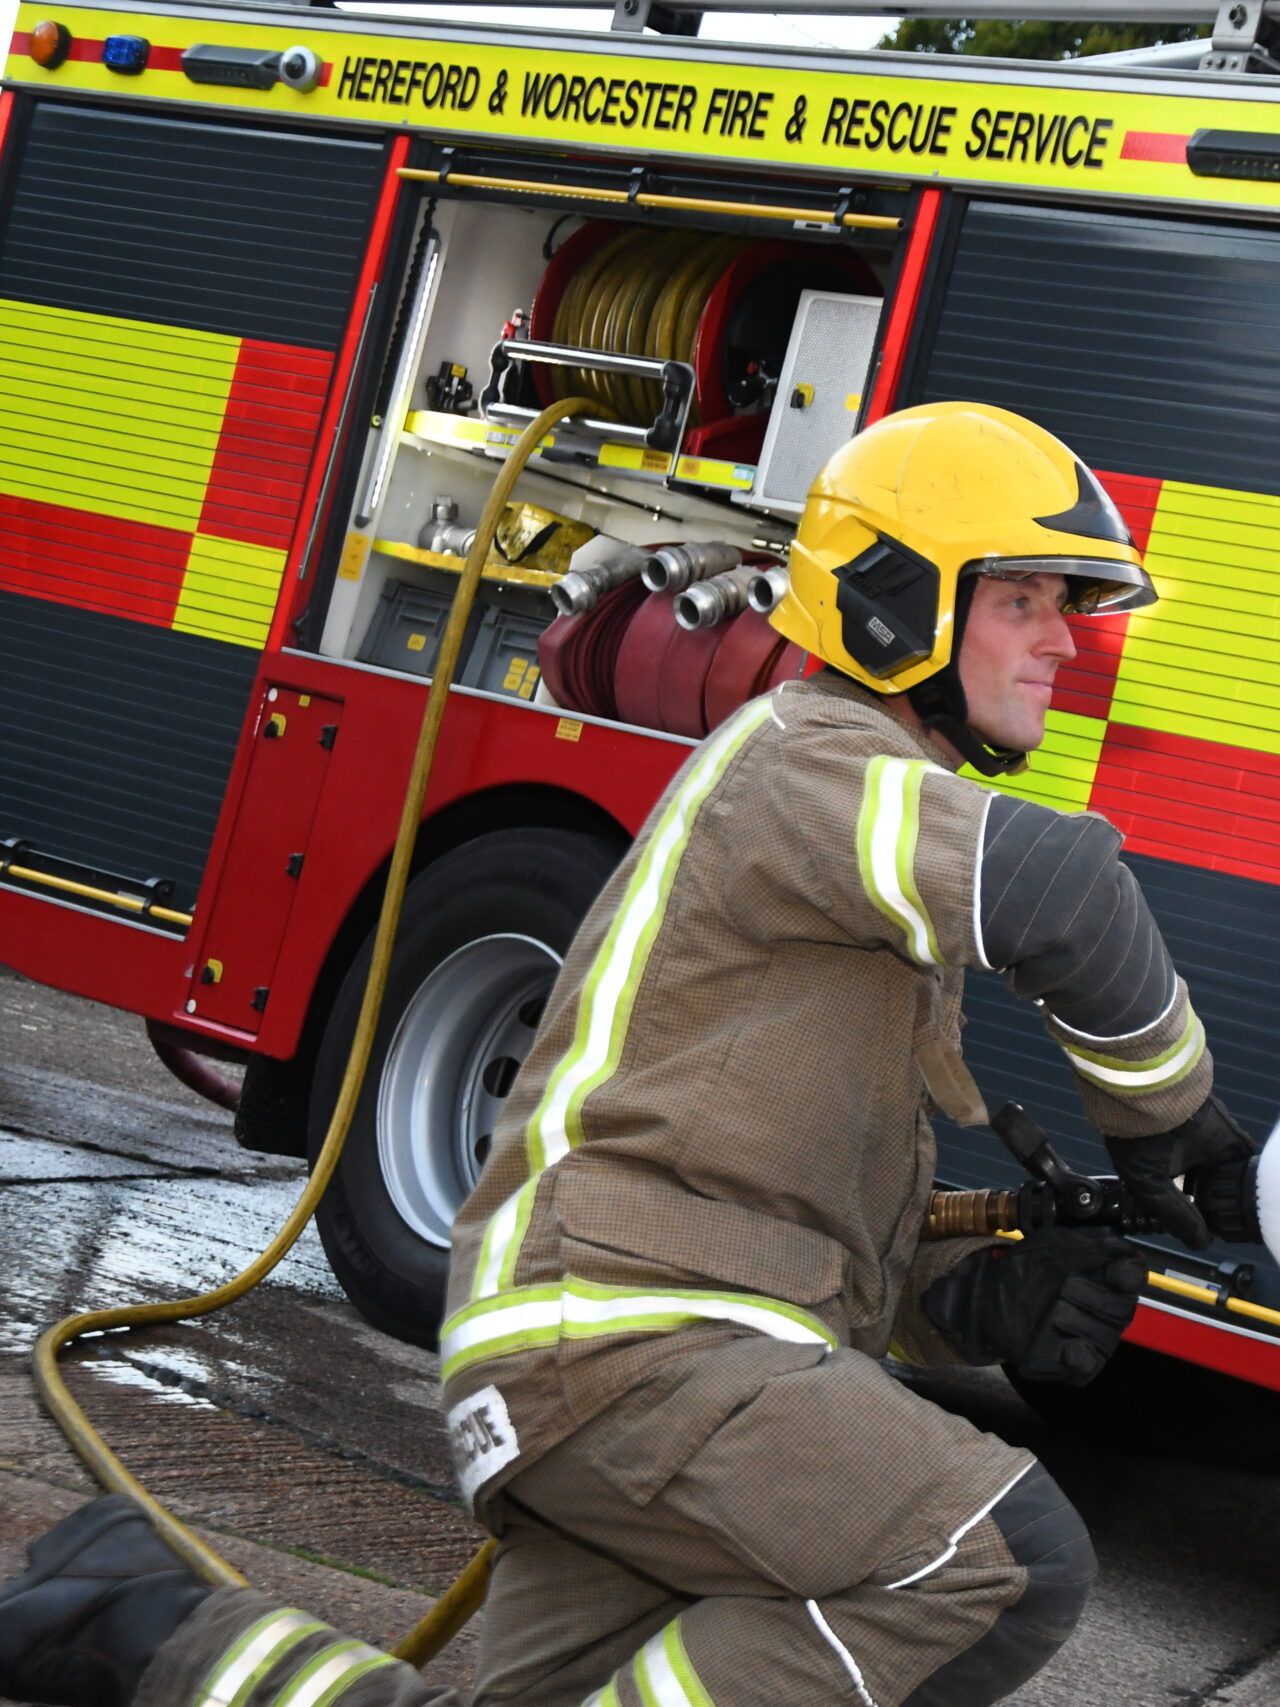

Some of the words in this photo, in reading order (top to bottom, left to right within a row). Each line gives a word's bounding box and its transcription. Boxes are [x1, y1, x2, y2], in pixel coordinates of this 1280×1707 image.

[337, 56, 480, 111] HEREFORD
[488, 69, 508, 114] &
[521, 71, 697, 132] WORCESTER
[703, 88, 774, 139] FIRE
[784, 94, 807, 144] &
[822, 97, 957, 156] RESCUE
[965, 108, 1114, 168] SERVICE
[870, 618, 894, 643] MSA
